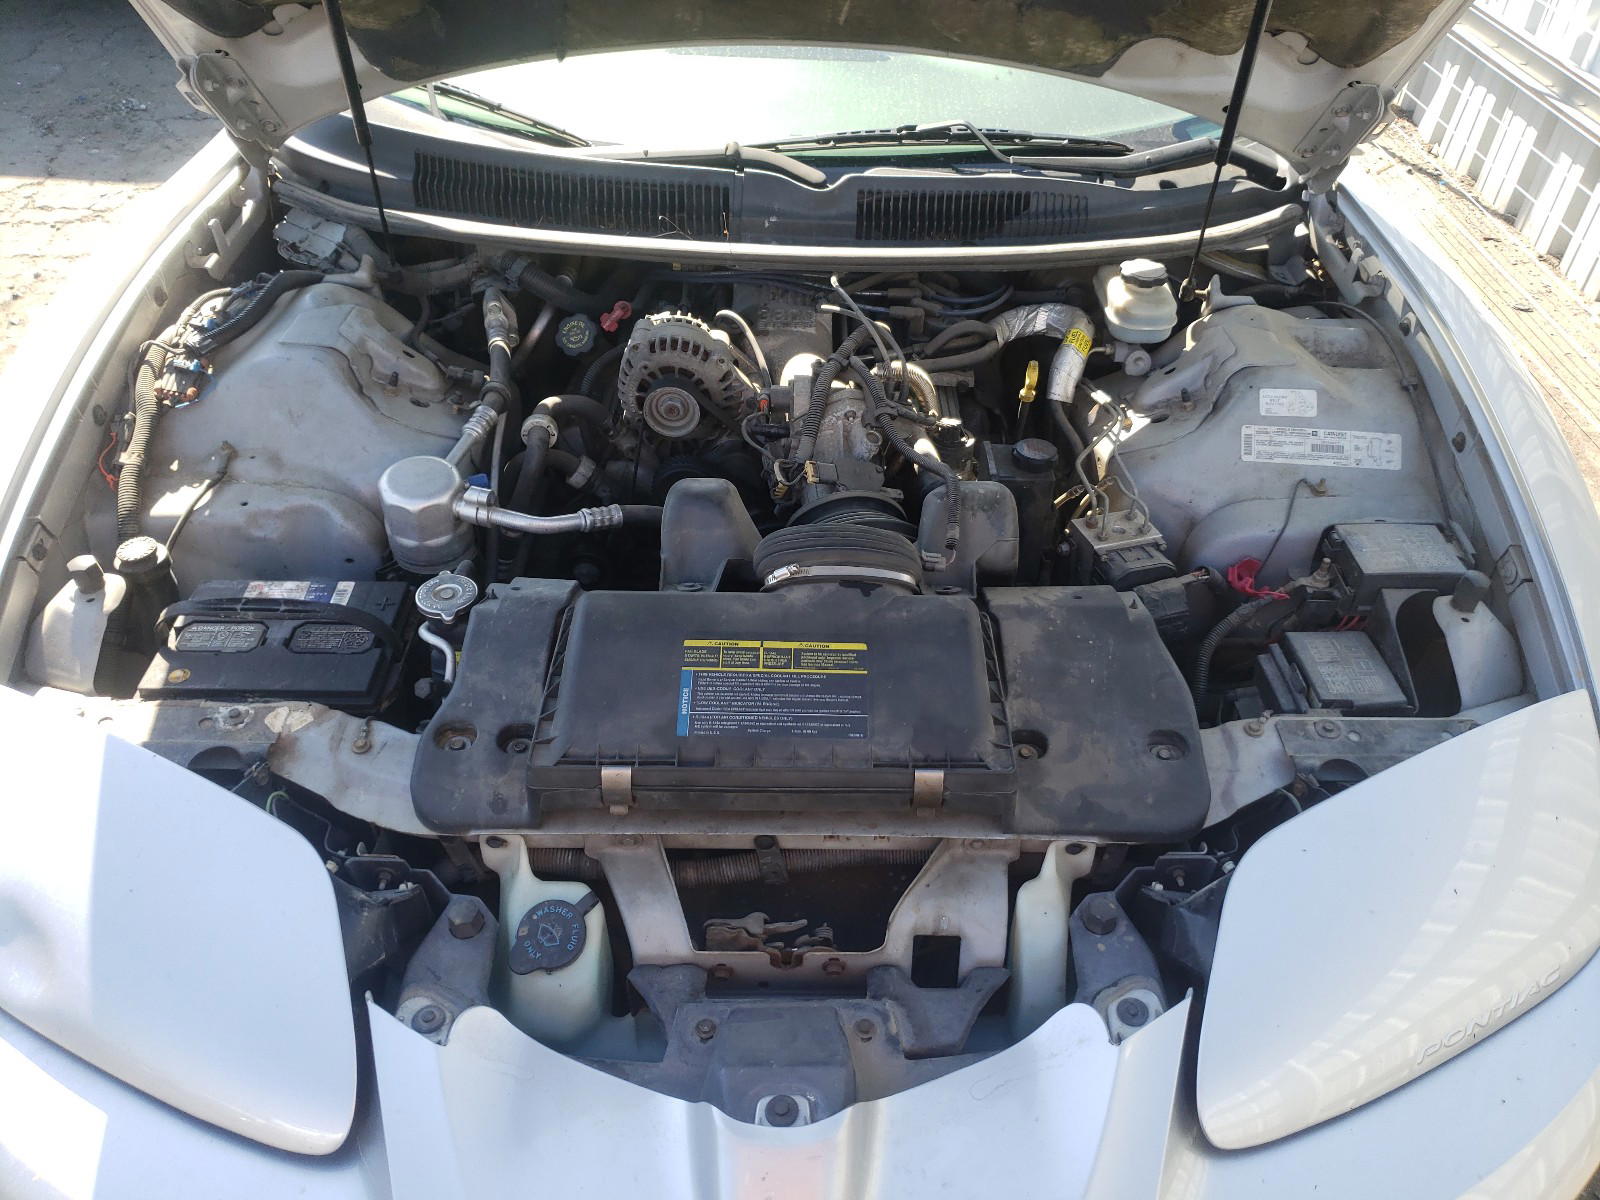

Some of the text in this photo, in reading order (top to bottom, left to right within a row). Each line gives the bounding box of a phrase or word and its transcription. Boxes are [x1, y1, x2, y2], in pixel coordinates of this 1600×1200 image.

[681, 687, 690, 715] NOTICE
[523, 905, 580, 960] WASHER FLUID ONLY
[1415, 965, 1560, 1065] PONTIAC
